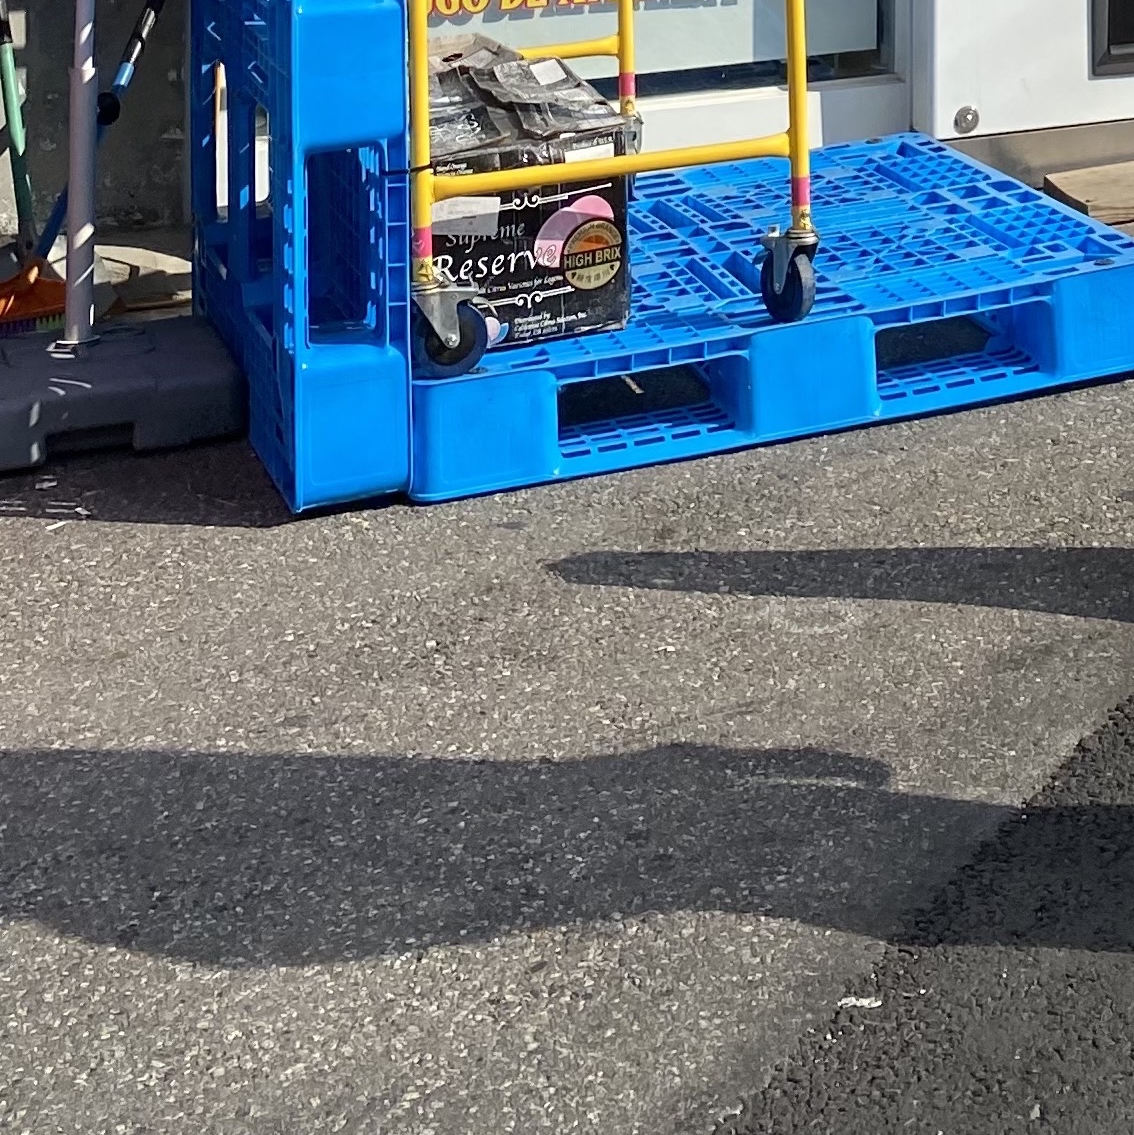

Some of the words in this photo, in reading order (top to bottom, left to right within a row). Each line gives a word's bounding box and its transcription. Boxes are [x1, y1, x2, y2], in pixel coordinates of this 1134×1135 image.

[432, 244, 557, 282] Reserve
[563, 251, 593, 270] HIGH
[595, 246, 622, 264] BRIX
